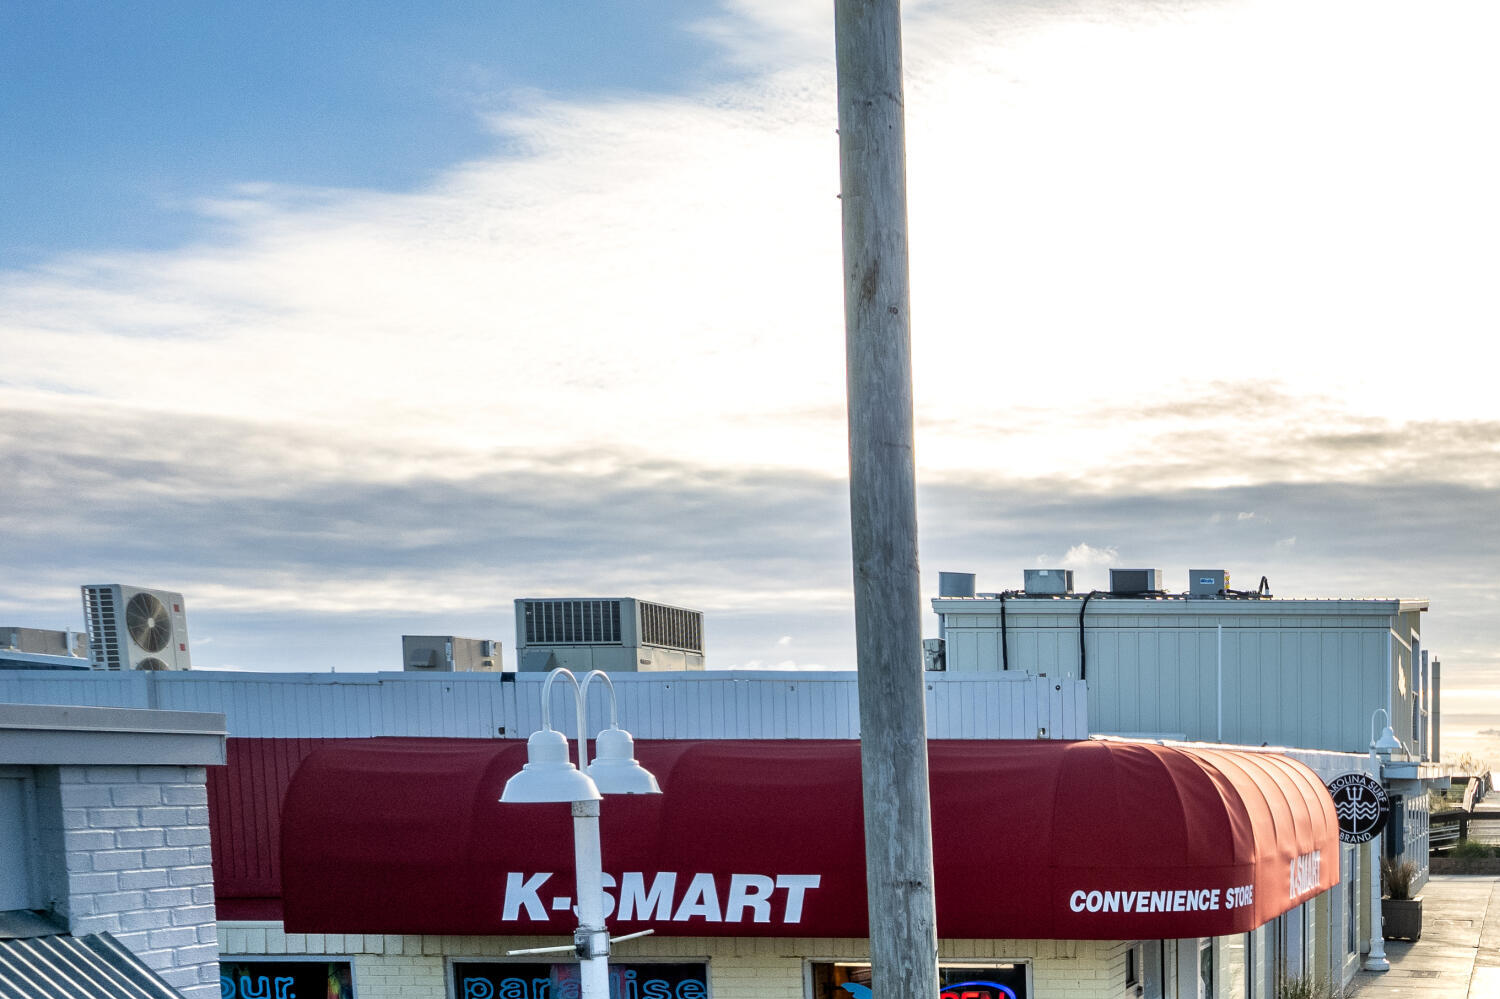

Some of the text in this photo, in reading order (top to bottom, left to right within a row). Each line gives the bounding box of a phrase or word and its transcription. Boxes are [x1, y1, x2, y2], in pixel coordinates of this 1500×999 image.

[1329, 775, 1387, 802] AROLINA SURF
[1340, 832, 1371, 843] BRAND
[1069, 884, 1253, 913] CONVENIENCE STORE
